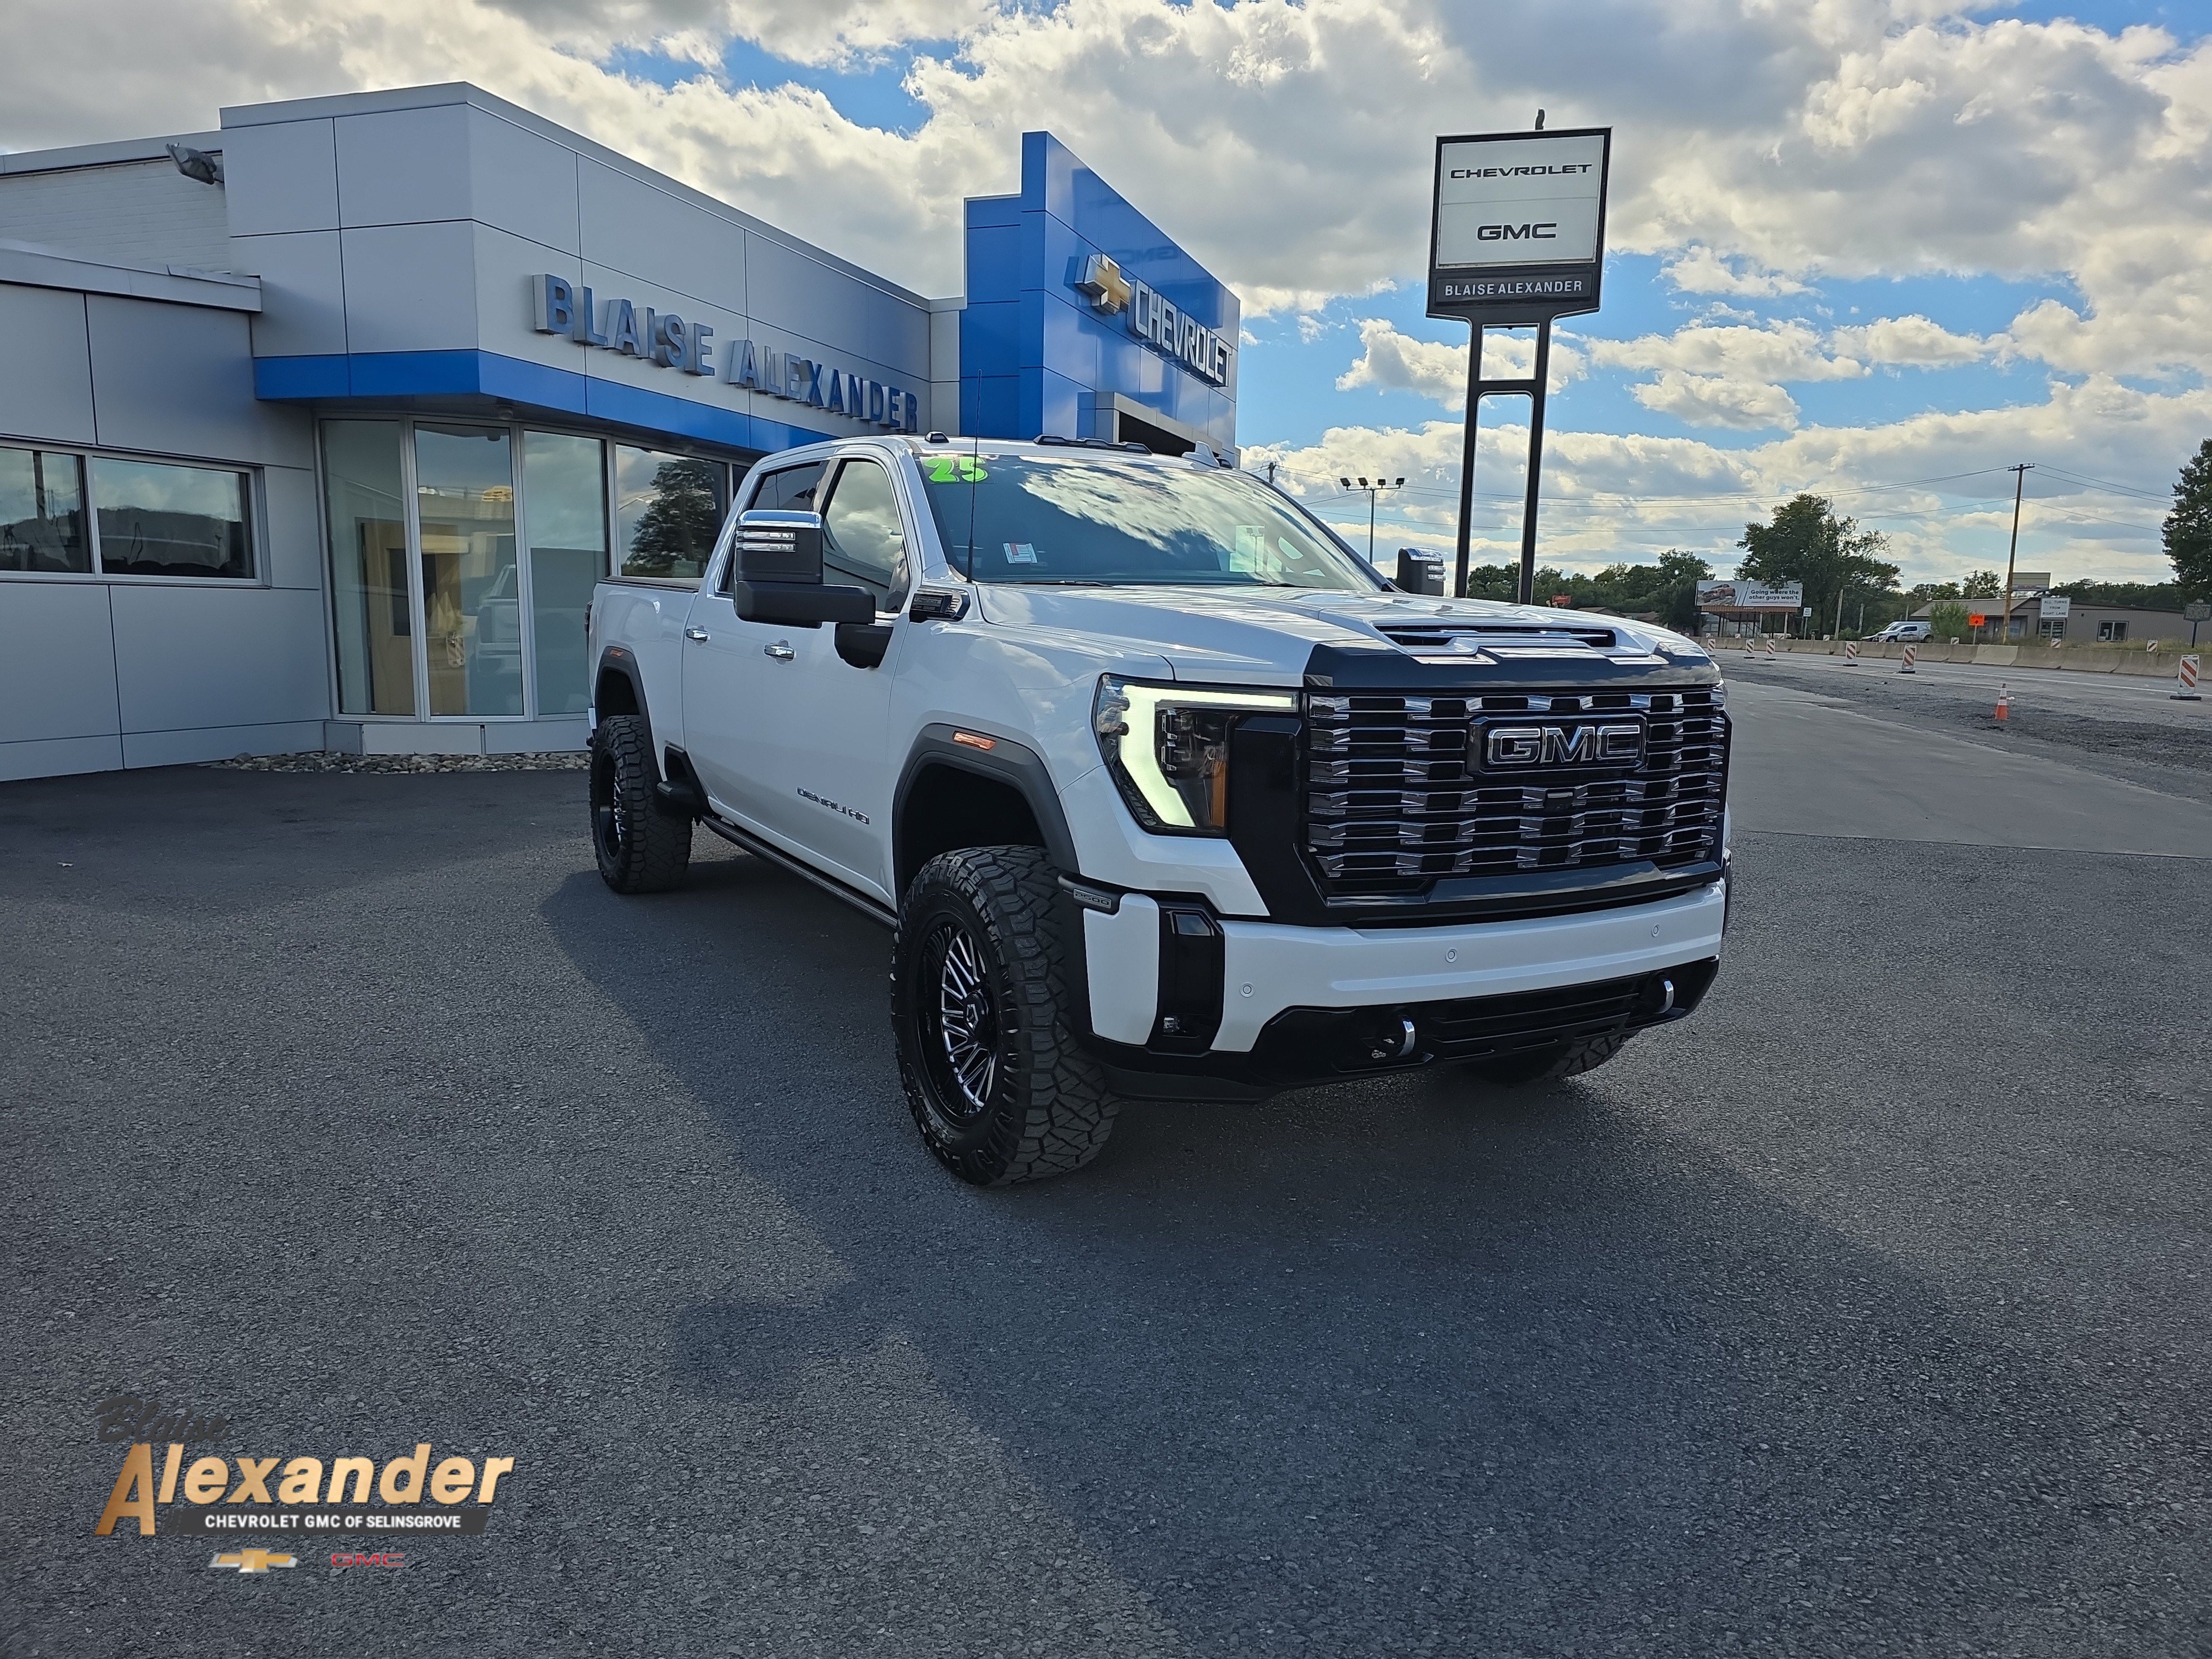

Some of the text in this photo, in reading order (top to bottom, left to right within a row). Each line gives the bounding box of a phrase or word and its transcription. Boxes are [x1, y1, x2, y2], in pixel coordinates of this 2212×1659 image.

[1450, 164, 1592, 178] CHEVROLET
[1477, 223, 1557, 240] GMC
[1445, 280, 1583, 296] BLAISE ALEXANDER
[1128, 279, 1233, 388] CHEVROLET
[532, 273, 918, 433] BLAISE ALEXANDER
[924, 456, 988, 483] 25
[1487, 724, 1641, 766] GMC
[797, 787, 870, 825] DENALI HD
